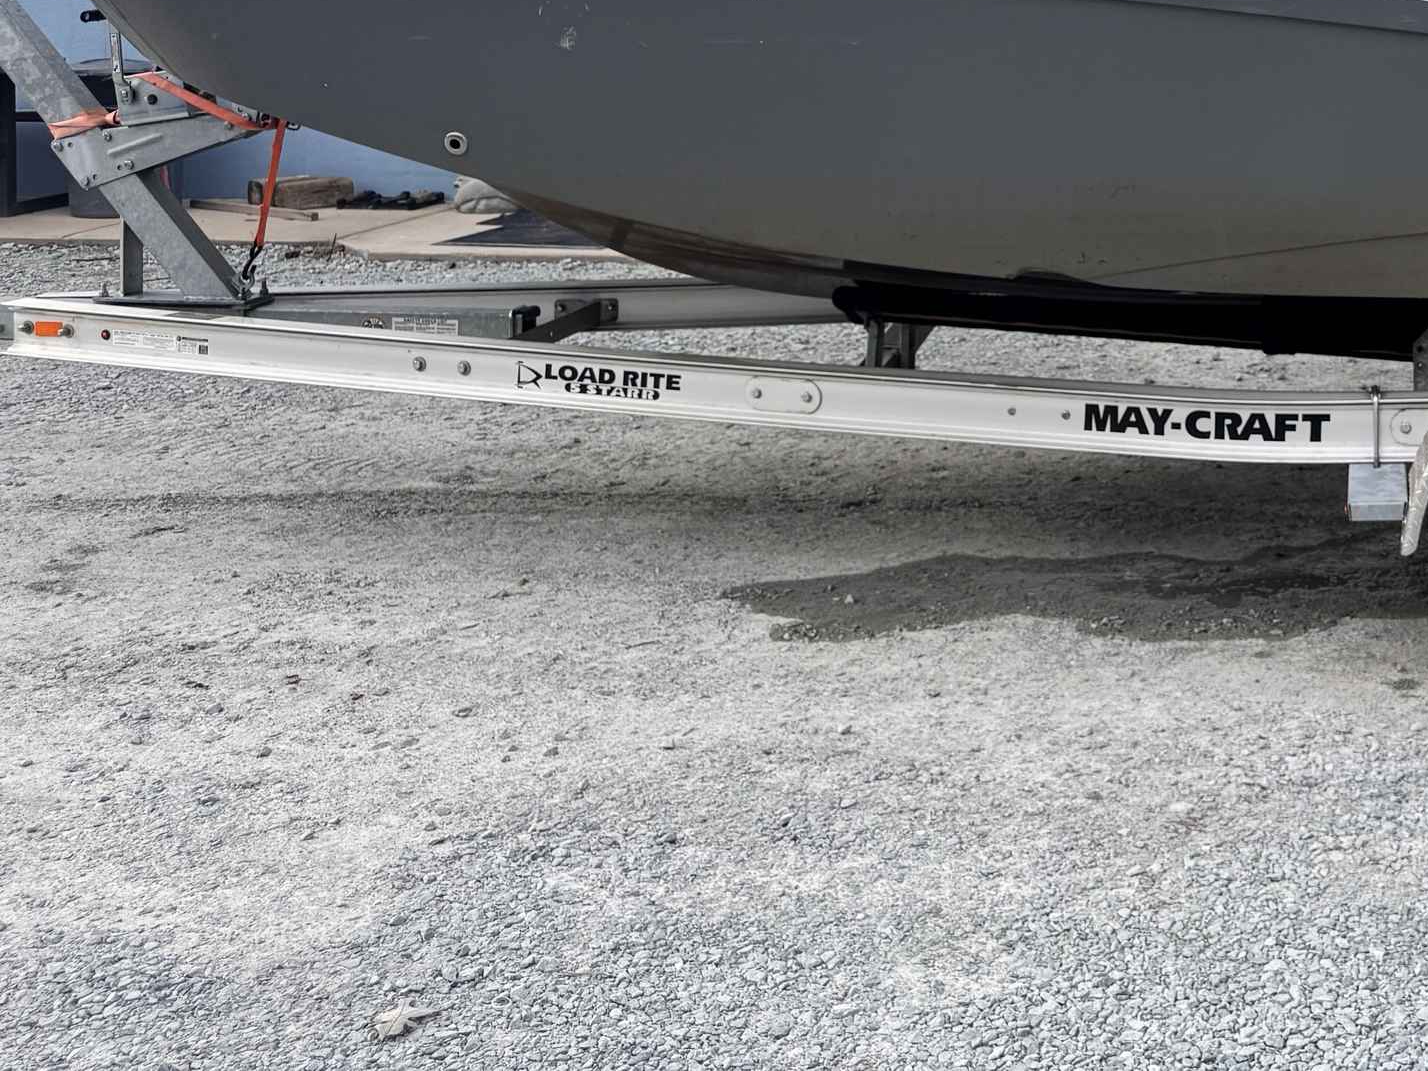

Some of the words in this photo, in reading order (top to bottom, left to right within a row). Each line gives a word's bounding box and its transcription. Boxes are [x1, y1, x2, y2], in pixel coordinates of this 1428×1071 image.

[544, 363, 616, 385] LOAD
[622, 370, 682, 391] RITE
[1083, 403, 1331, 443] MAY-CRAFT
